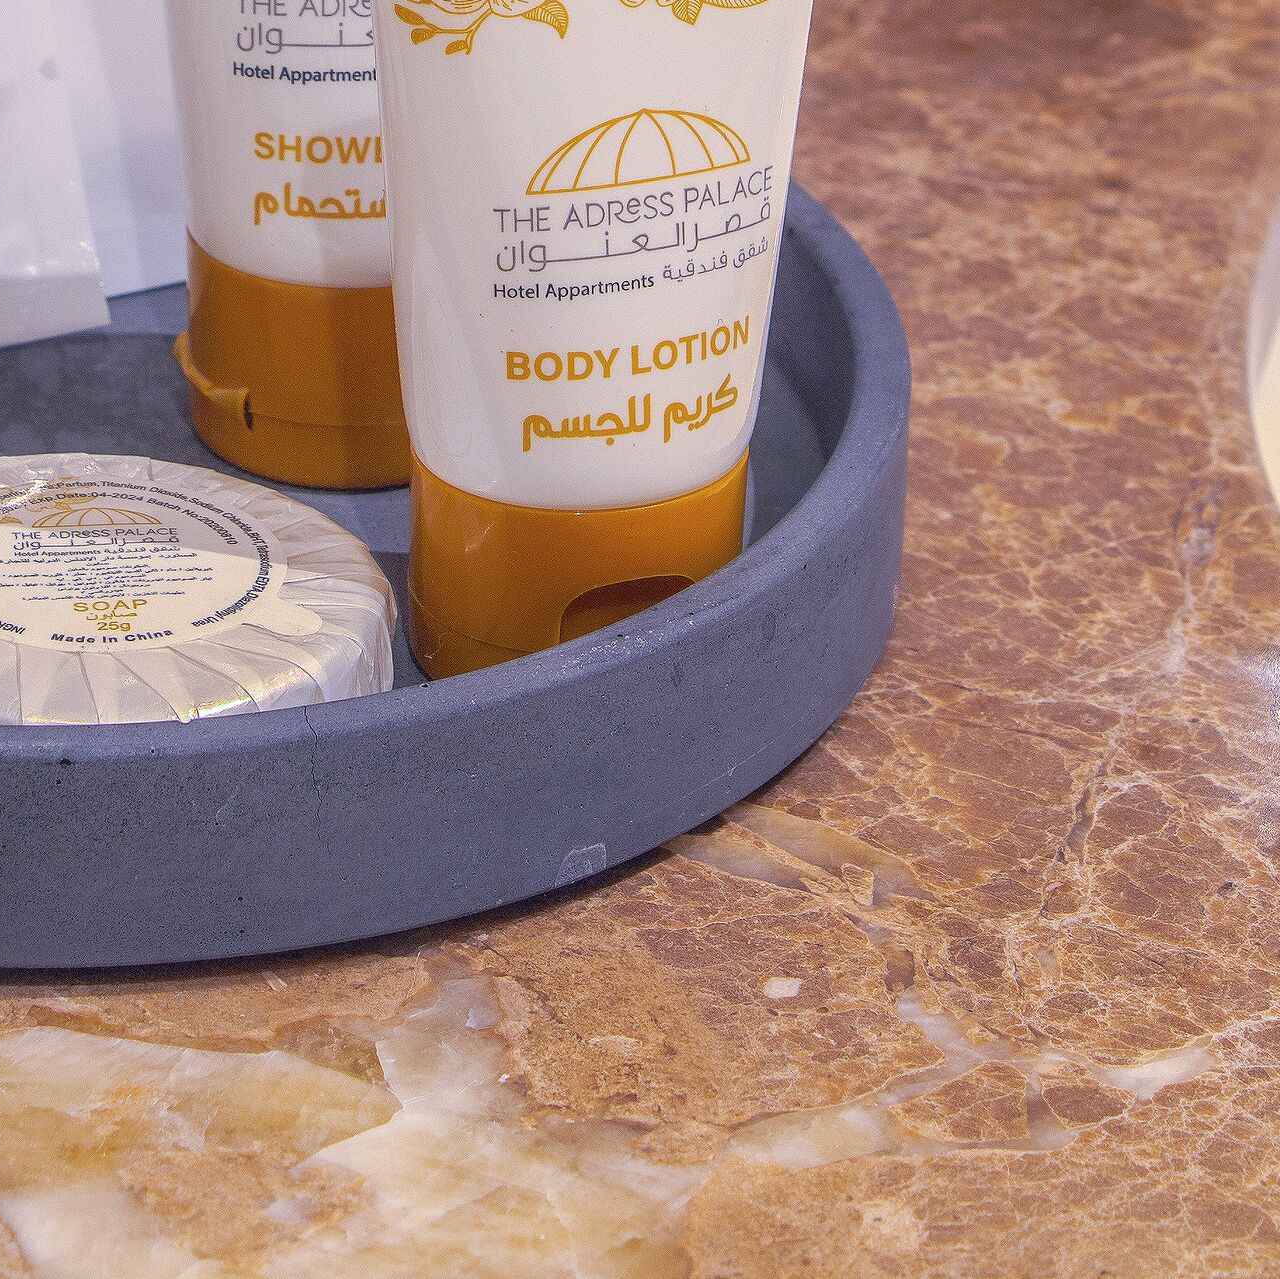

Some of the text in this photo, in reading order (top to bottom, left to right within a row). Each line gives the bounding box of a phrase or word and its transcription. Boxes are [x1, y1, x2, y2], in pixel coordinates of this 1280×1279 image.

[233, 61, 275, 80] Hotel
[493, 204, 551, 233] THE
[683, 165, 774, 213] PALACE
[496, 196, 772, 273] قصر العنوان
[662, 236, 770, 283] شقق فندقية
[493, 275, 655, 301] Hotel Appartments
[506, 315, 751, 382] BODY LOTION
[522, 373, 740, 452] كريم للجسم
[147, 497, 181, 512] Batch
[12, 531, 42, 540] THE
[115, 527, 178, 536] PALACE
[73, 599, 148, 612] SOAP
[86, 609, 138, 621] صابون
[51, 633, 96, 643] Made
[124, 629, 174, 642] China
[96, 621, 131, 632] 25g
